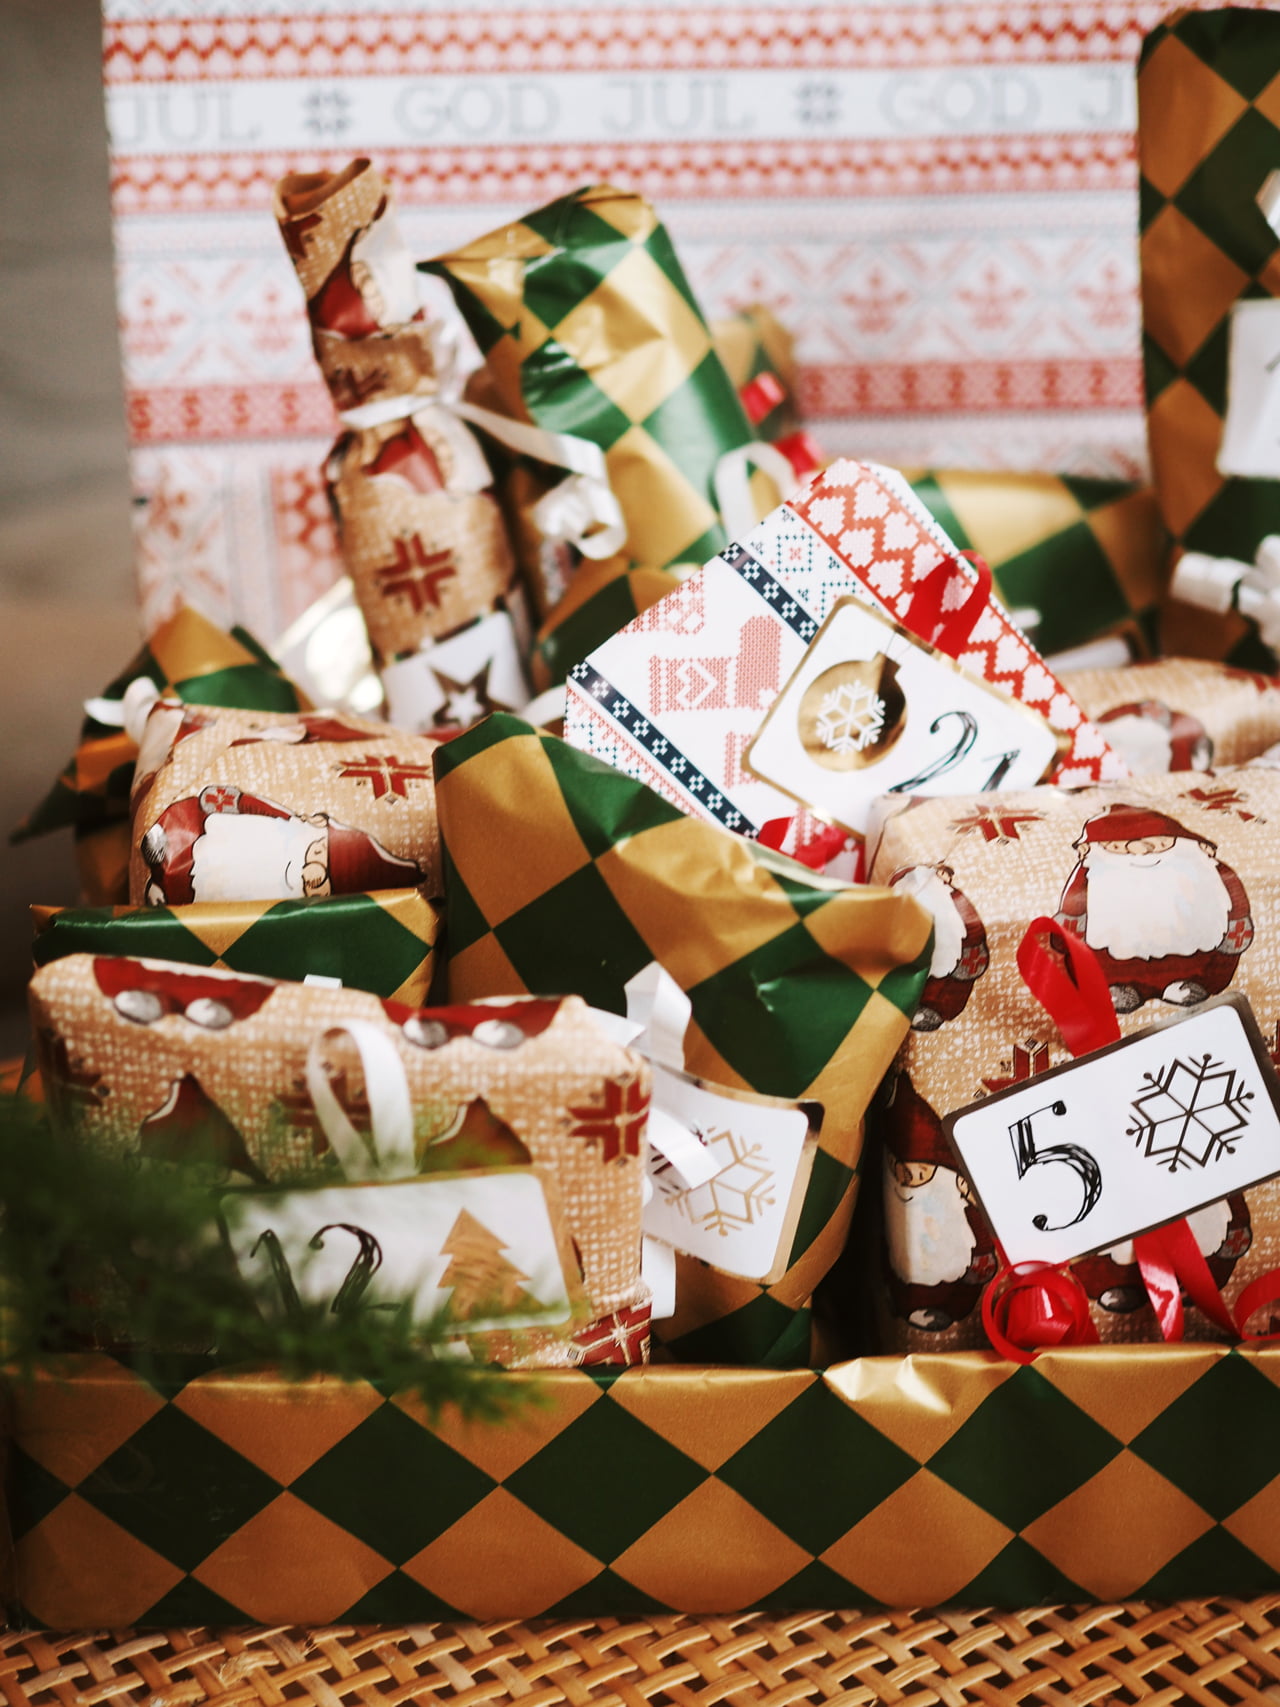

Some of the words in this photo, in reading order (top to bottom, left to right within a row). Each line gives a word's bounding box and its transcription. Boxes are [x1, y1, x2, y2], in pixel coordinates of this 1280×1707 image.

[108, 89, 263, 146] JUL
[393, 77, 561, 138] GOD
[601, 73, 757, 134] JUL
[879, 68, 1042, 133] GOD
[1008, 1100, 1102, 1231] 5
